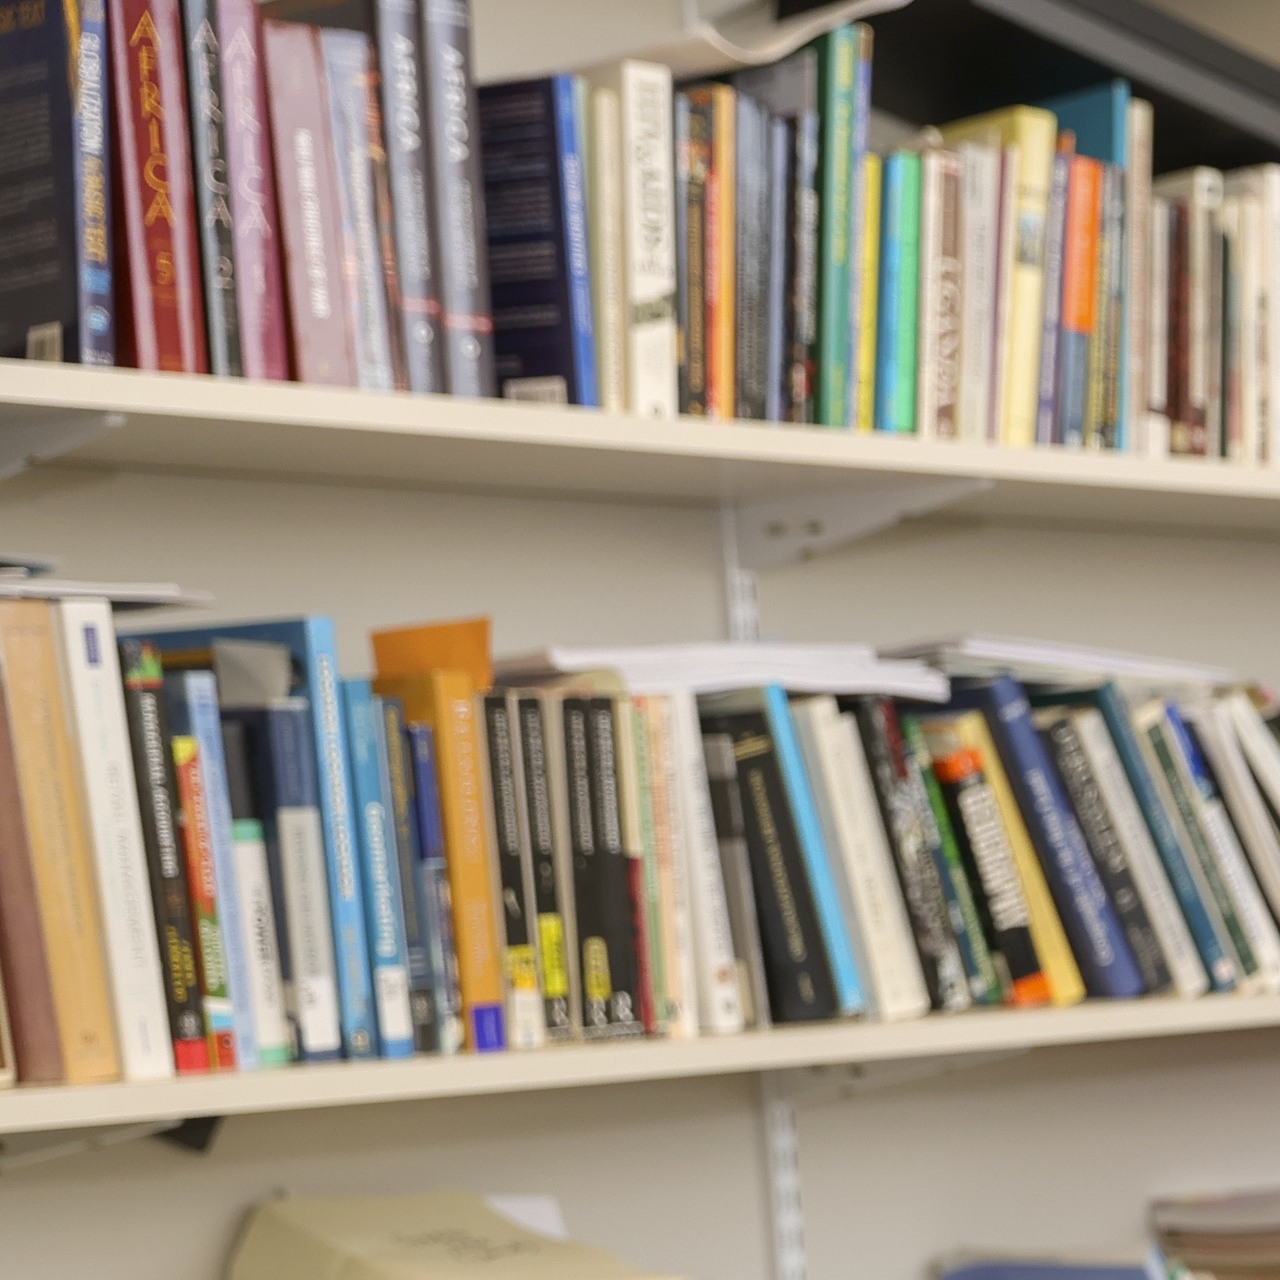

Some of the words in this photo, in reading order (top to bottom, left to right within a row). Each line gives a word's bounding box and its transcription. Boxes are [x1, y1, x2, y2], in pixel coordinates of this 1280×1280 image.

[129, 9, 176, 230] AFRICA
[190, 18, 233, 230] AFRICA
[223, 25, 273, 239] AFRICA
[390, 31, 423, 155] AFRICA
[440, 42, 471, 163] AFRICA
[365, 802, 400, 957] Geomarketing
